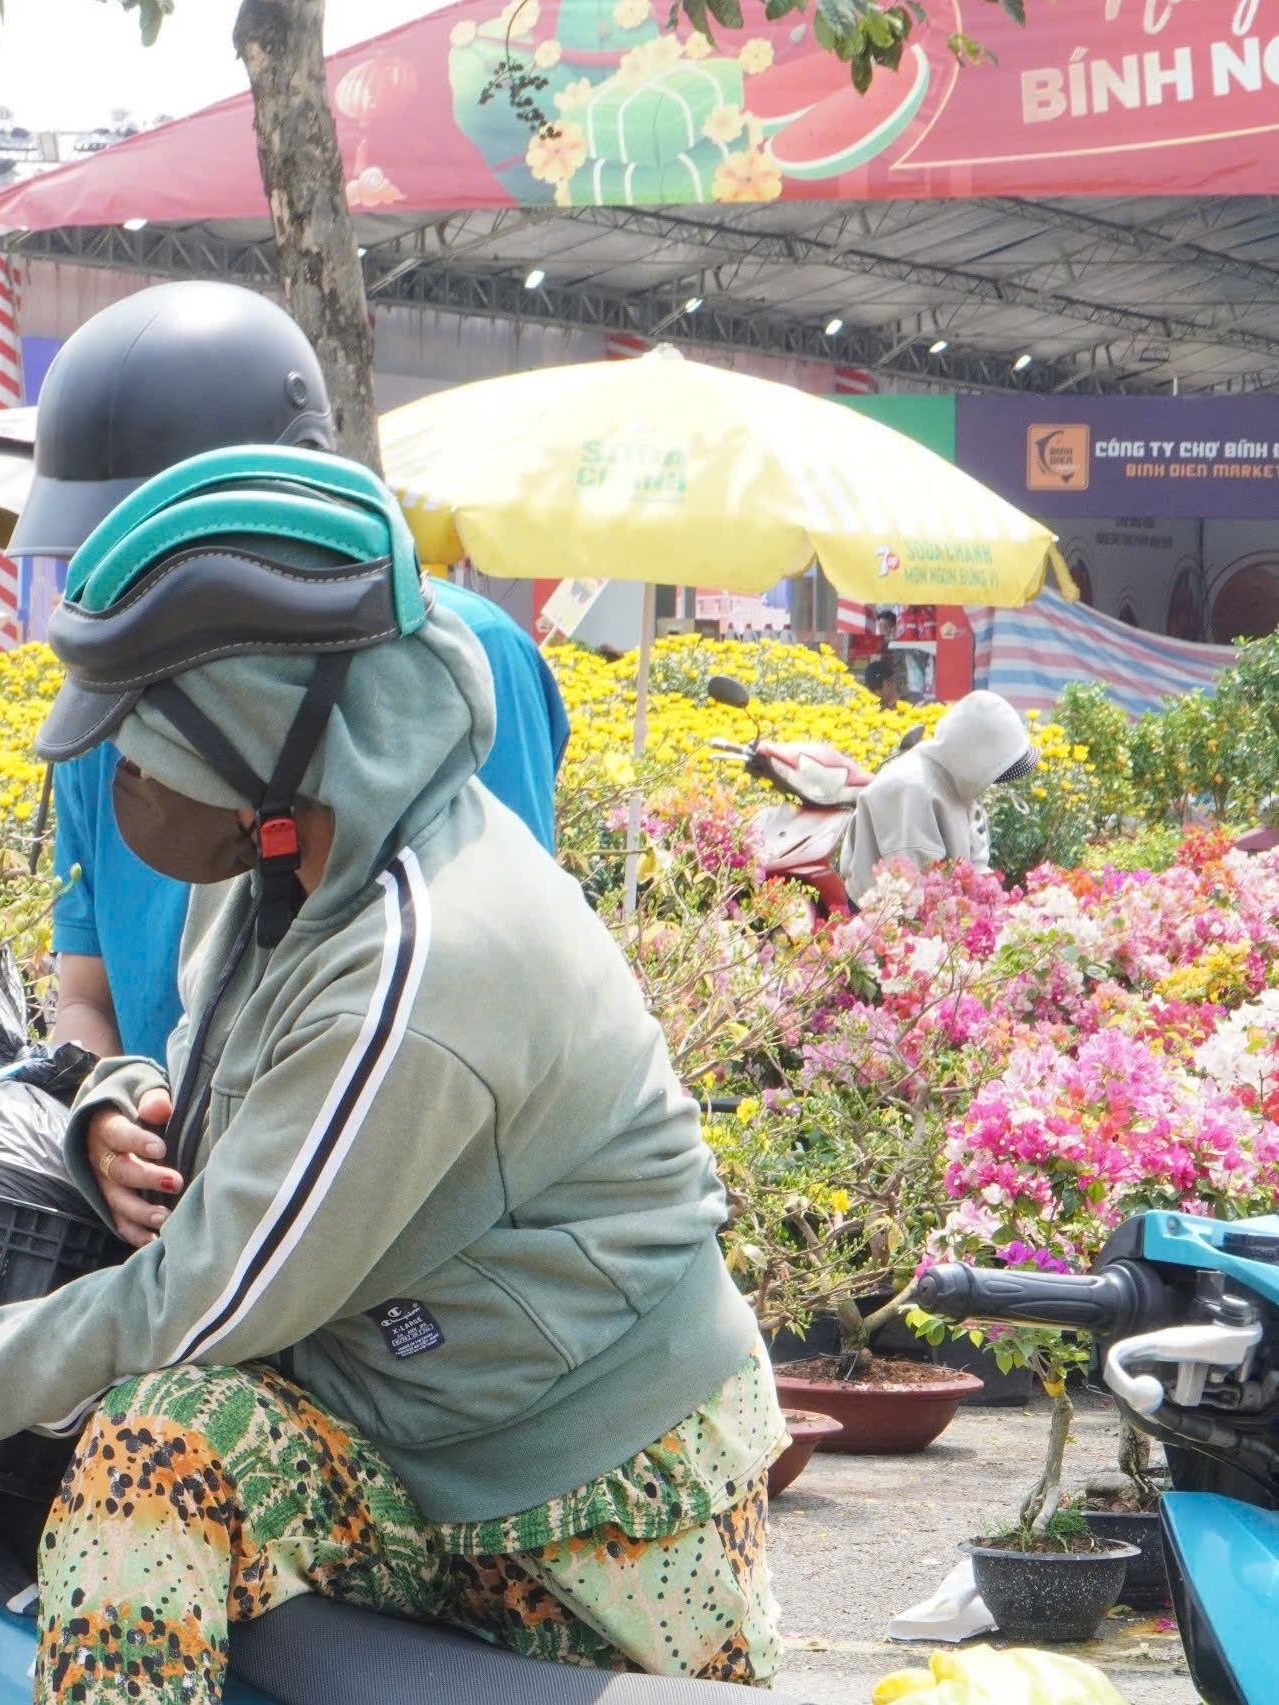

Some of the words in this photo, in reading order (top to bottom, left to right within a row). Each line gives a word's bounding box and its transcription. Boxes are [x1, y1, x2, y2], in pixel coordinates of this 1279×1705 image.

[1021, 46, 1194, 124] BÍNH
[1095, 438, 1145, 458] CÔNG
[1149, 441, 1175, 458] TY
[1179, 441, 1221, 461] CHỢ
[1126, 464, 1165, 478] BINH
[1169, 464, 1208, 478] DIEN
[392, 1316, 424, 1335] X-LARGE
